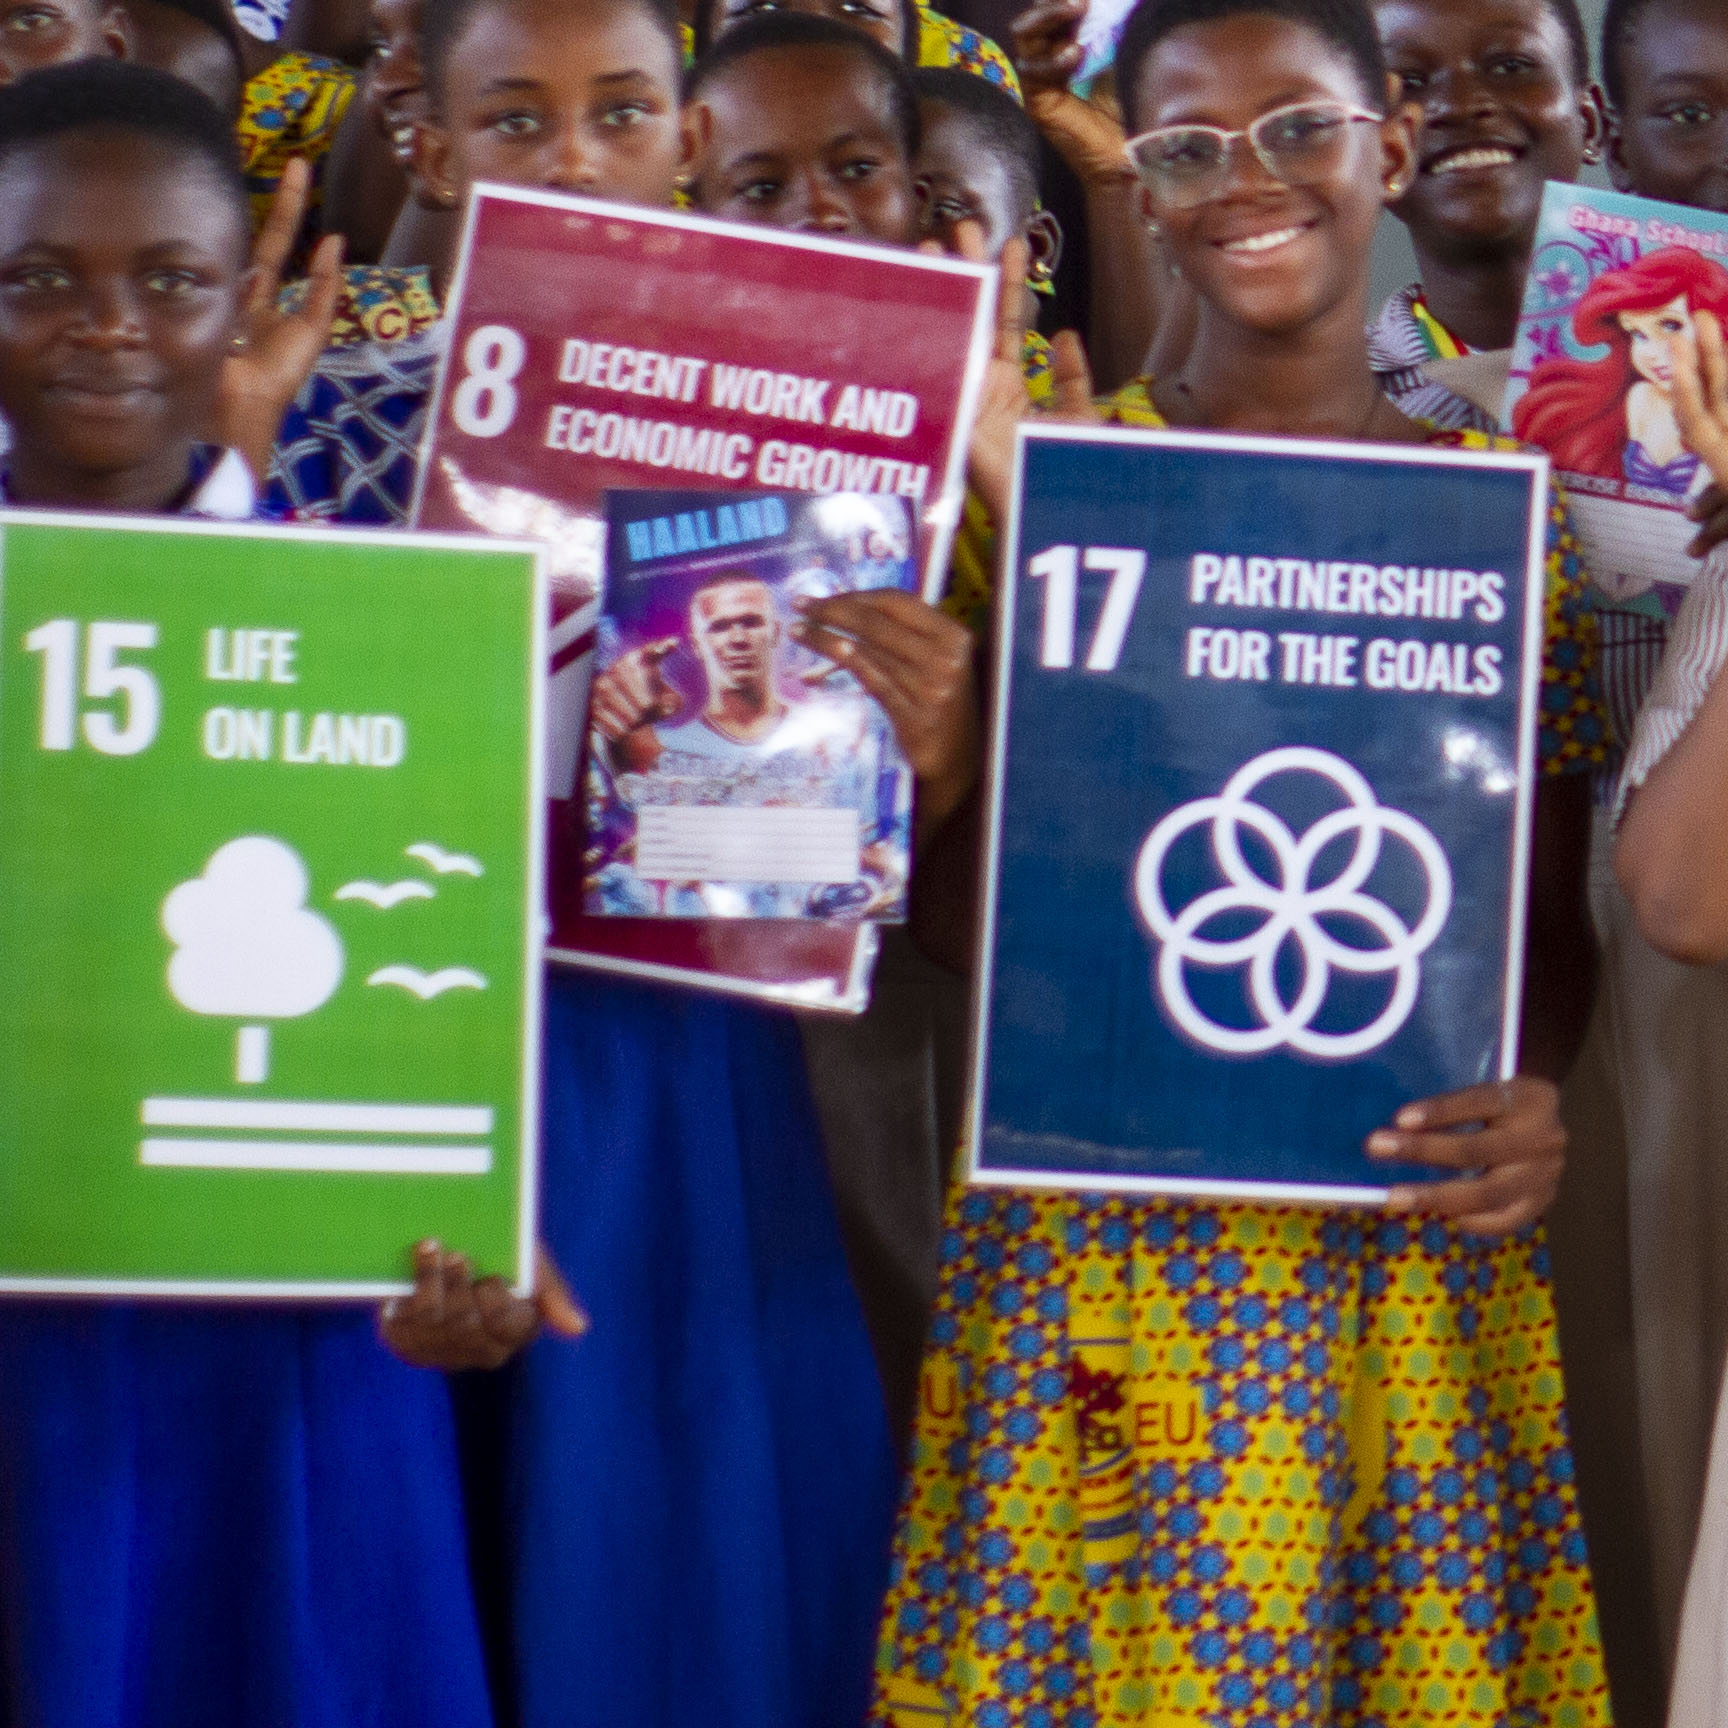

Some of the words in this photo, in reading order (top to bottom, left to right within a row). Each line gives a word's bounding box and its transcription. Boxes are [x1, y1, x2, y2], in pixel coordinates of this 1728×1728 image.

[1568, 203, 1640, 237] Ghana
[451, 324, 527, 438] 8
[557, 338, 707, 403] DECENT
[710, 361, 831, 426] WORK
[829, 383, 919, 439] AND
[544, 404, 755, 481] ECONOMIC
[755, 440, 930, 499] GROWTH
[626, 496, 788, 562] HAALAND
[1029, 544, 1148, 672] 17
[1189, 552, 1506, 623] PARTNERSHIPS
[24, 618, 162, 756] 15
[204, 626, 300, 684] LIFE
[1186, 626, 1271, 681] FOR
[1277, 632, 1359, 687] THE
[1364, 638, 1503, 697] GOALS
[203, 705, 272, 761] ON
[281, 711, 405, 768] LAND
